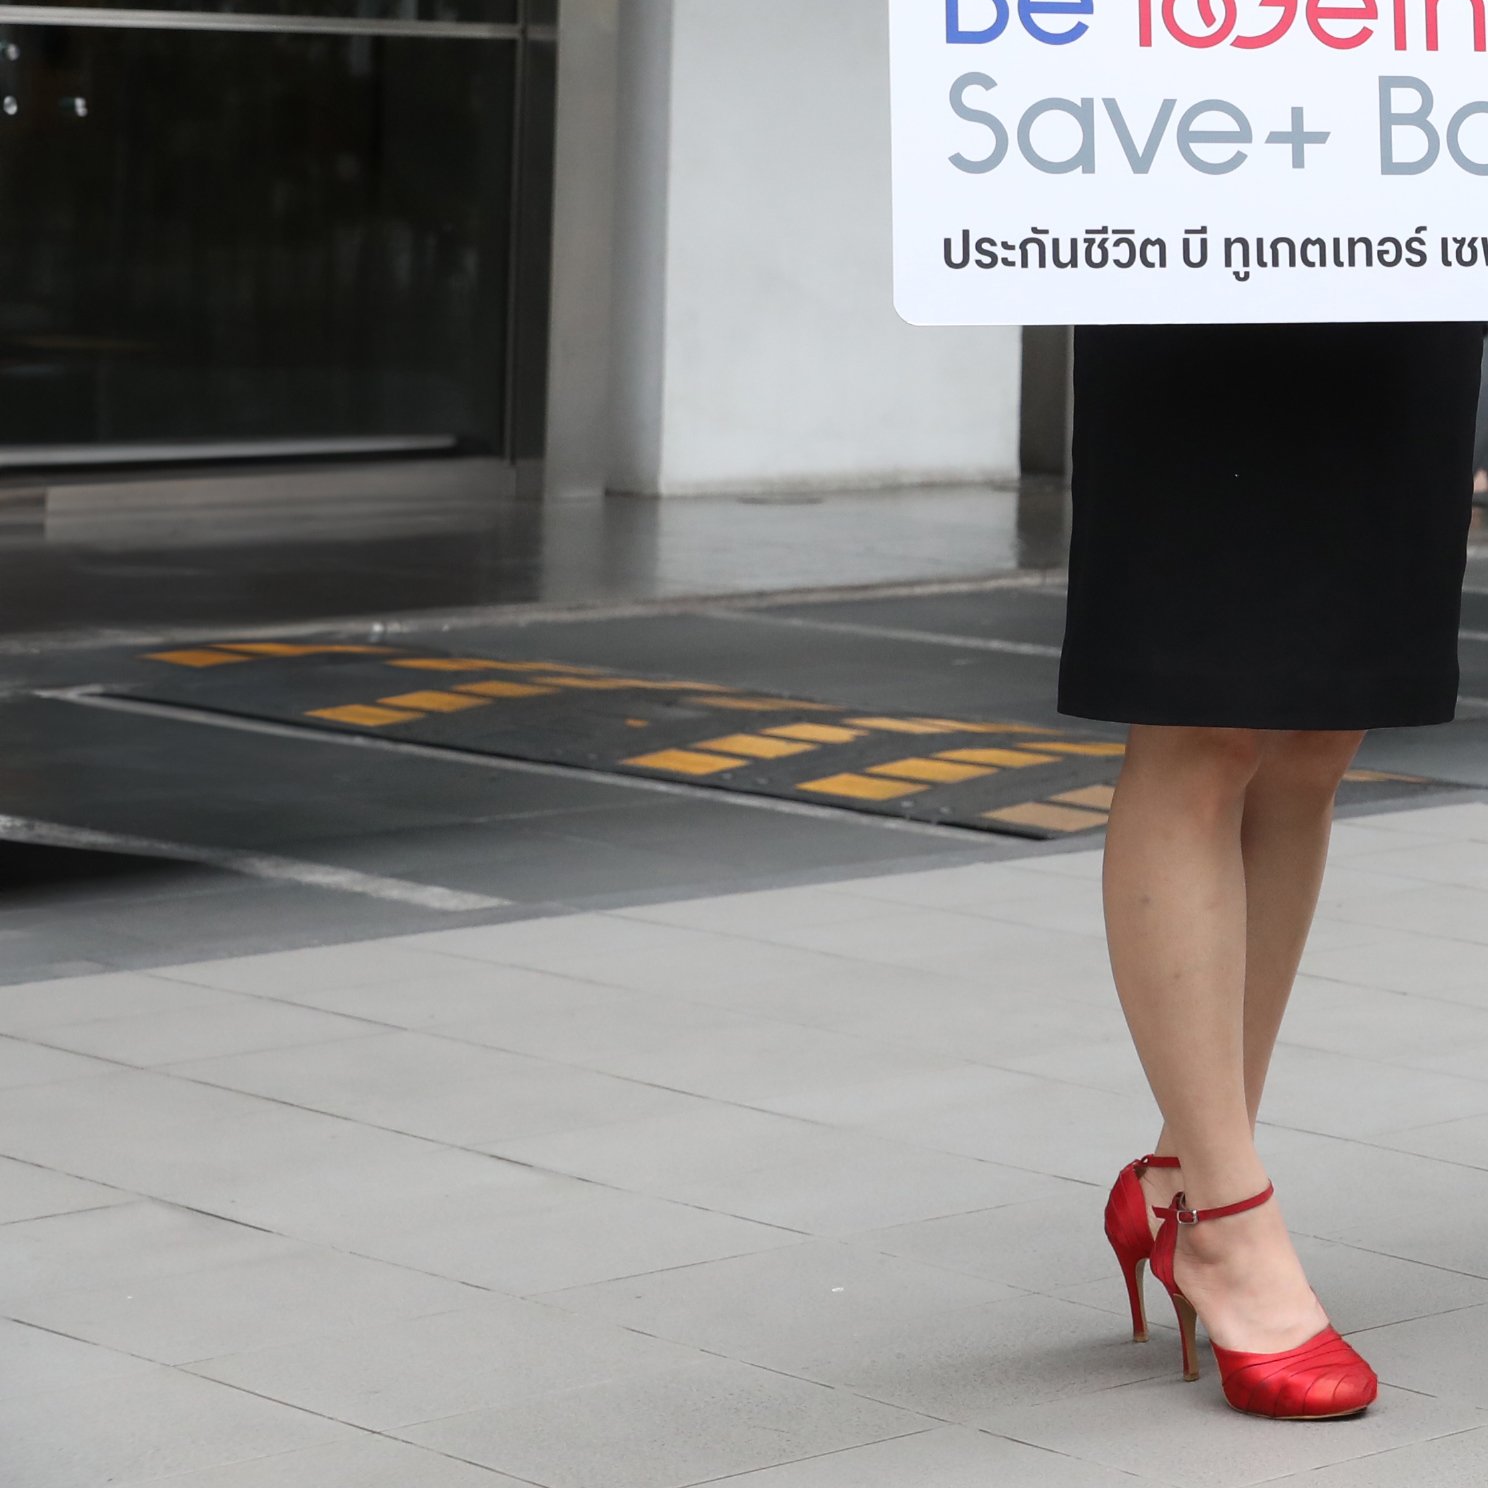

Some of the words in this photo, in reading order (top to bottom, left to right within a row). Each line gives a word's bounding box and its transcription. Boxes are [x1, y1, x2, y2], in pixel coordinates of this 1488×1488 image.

[947, 71, 1331, 176] Save+
[943, 225, 1167, 270] ประกันชีวิต
[1182, 225, 1208, 269] บี
[1224, 225, 1428, 282] ทูเกตเทอร์
